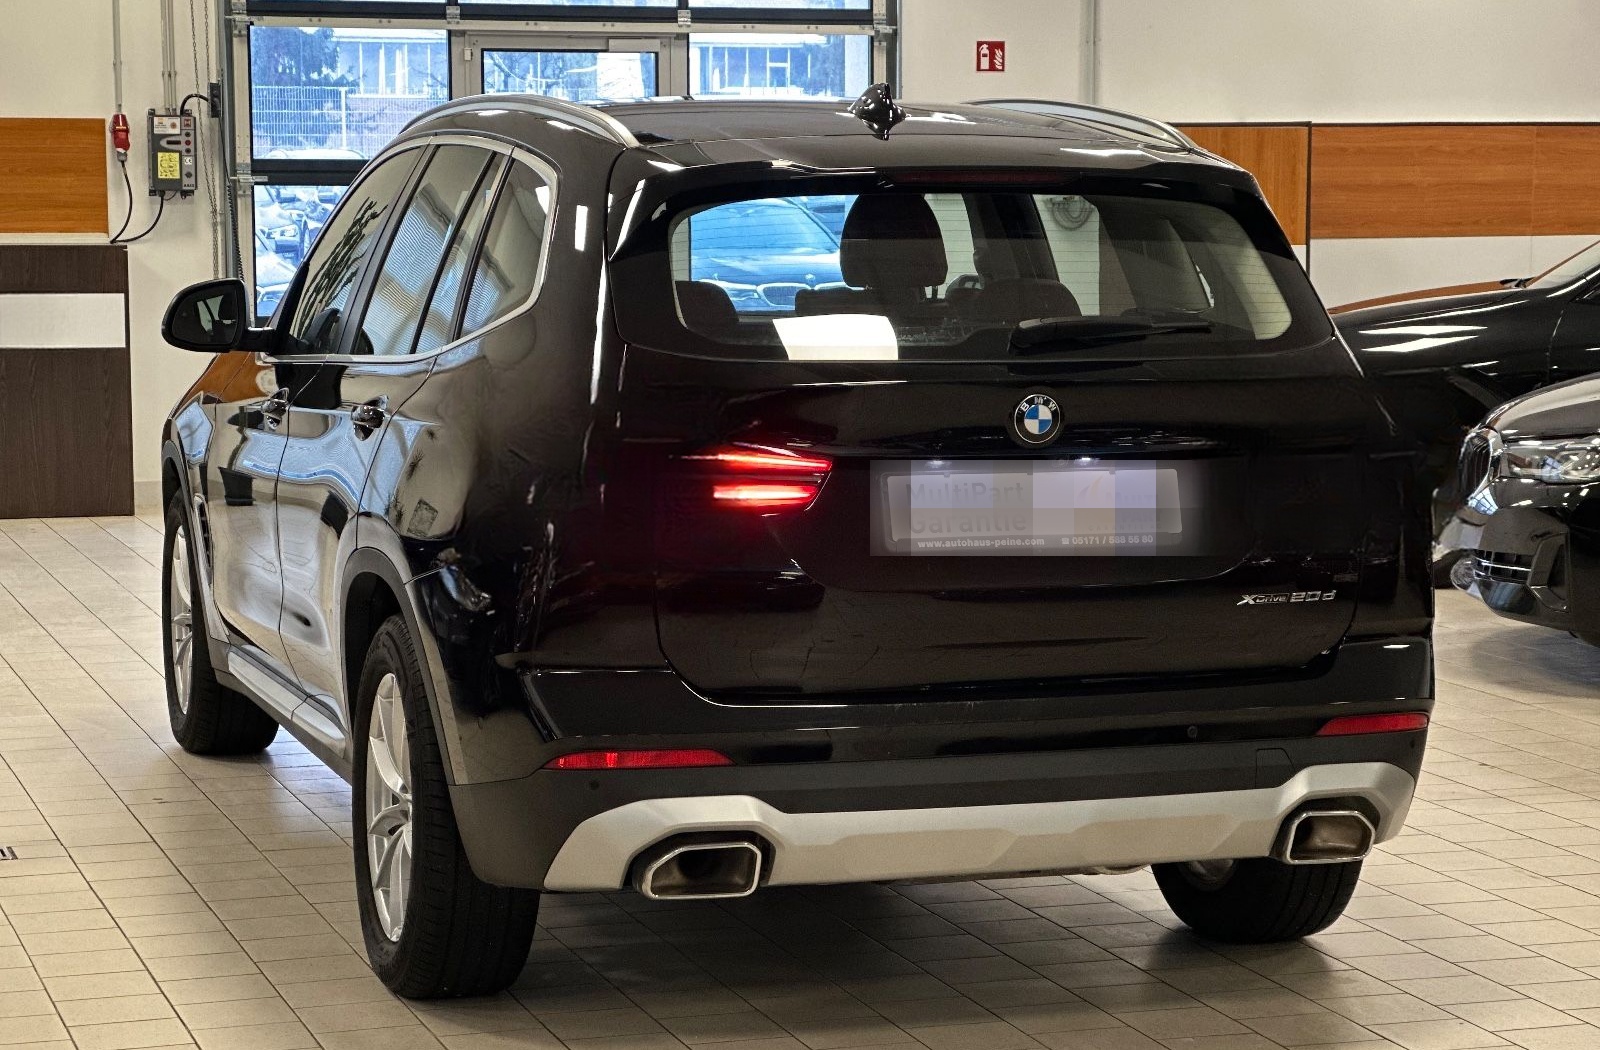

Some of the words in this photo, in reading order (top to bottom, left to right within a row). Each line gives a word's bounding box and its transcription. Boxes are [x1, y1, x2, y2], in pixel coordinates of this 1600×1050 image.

[1020, 396, 1057, 411] BMW
[918, 538, 1045, 547] www.autohaus-peine.com
[1072, 536, 1099, 545] 05171
[1128, 535, 1140, 544] 55
